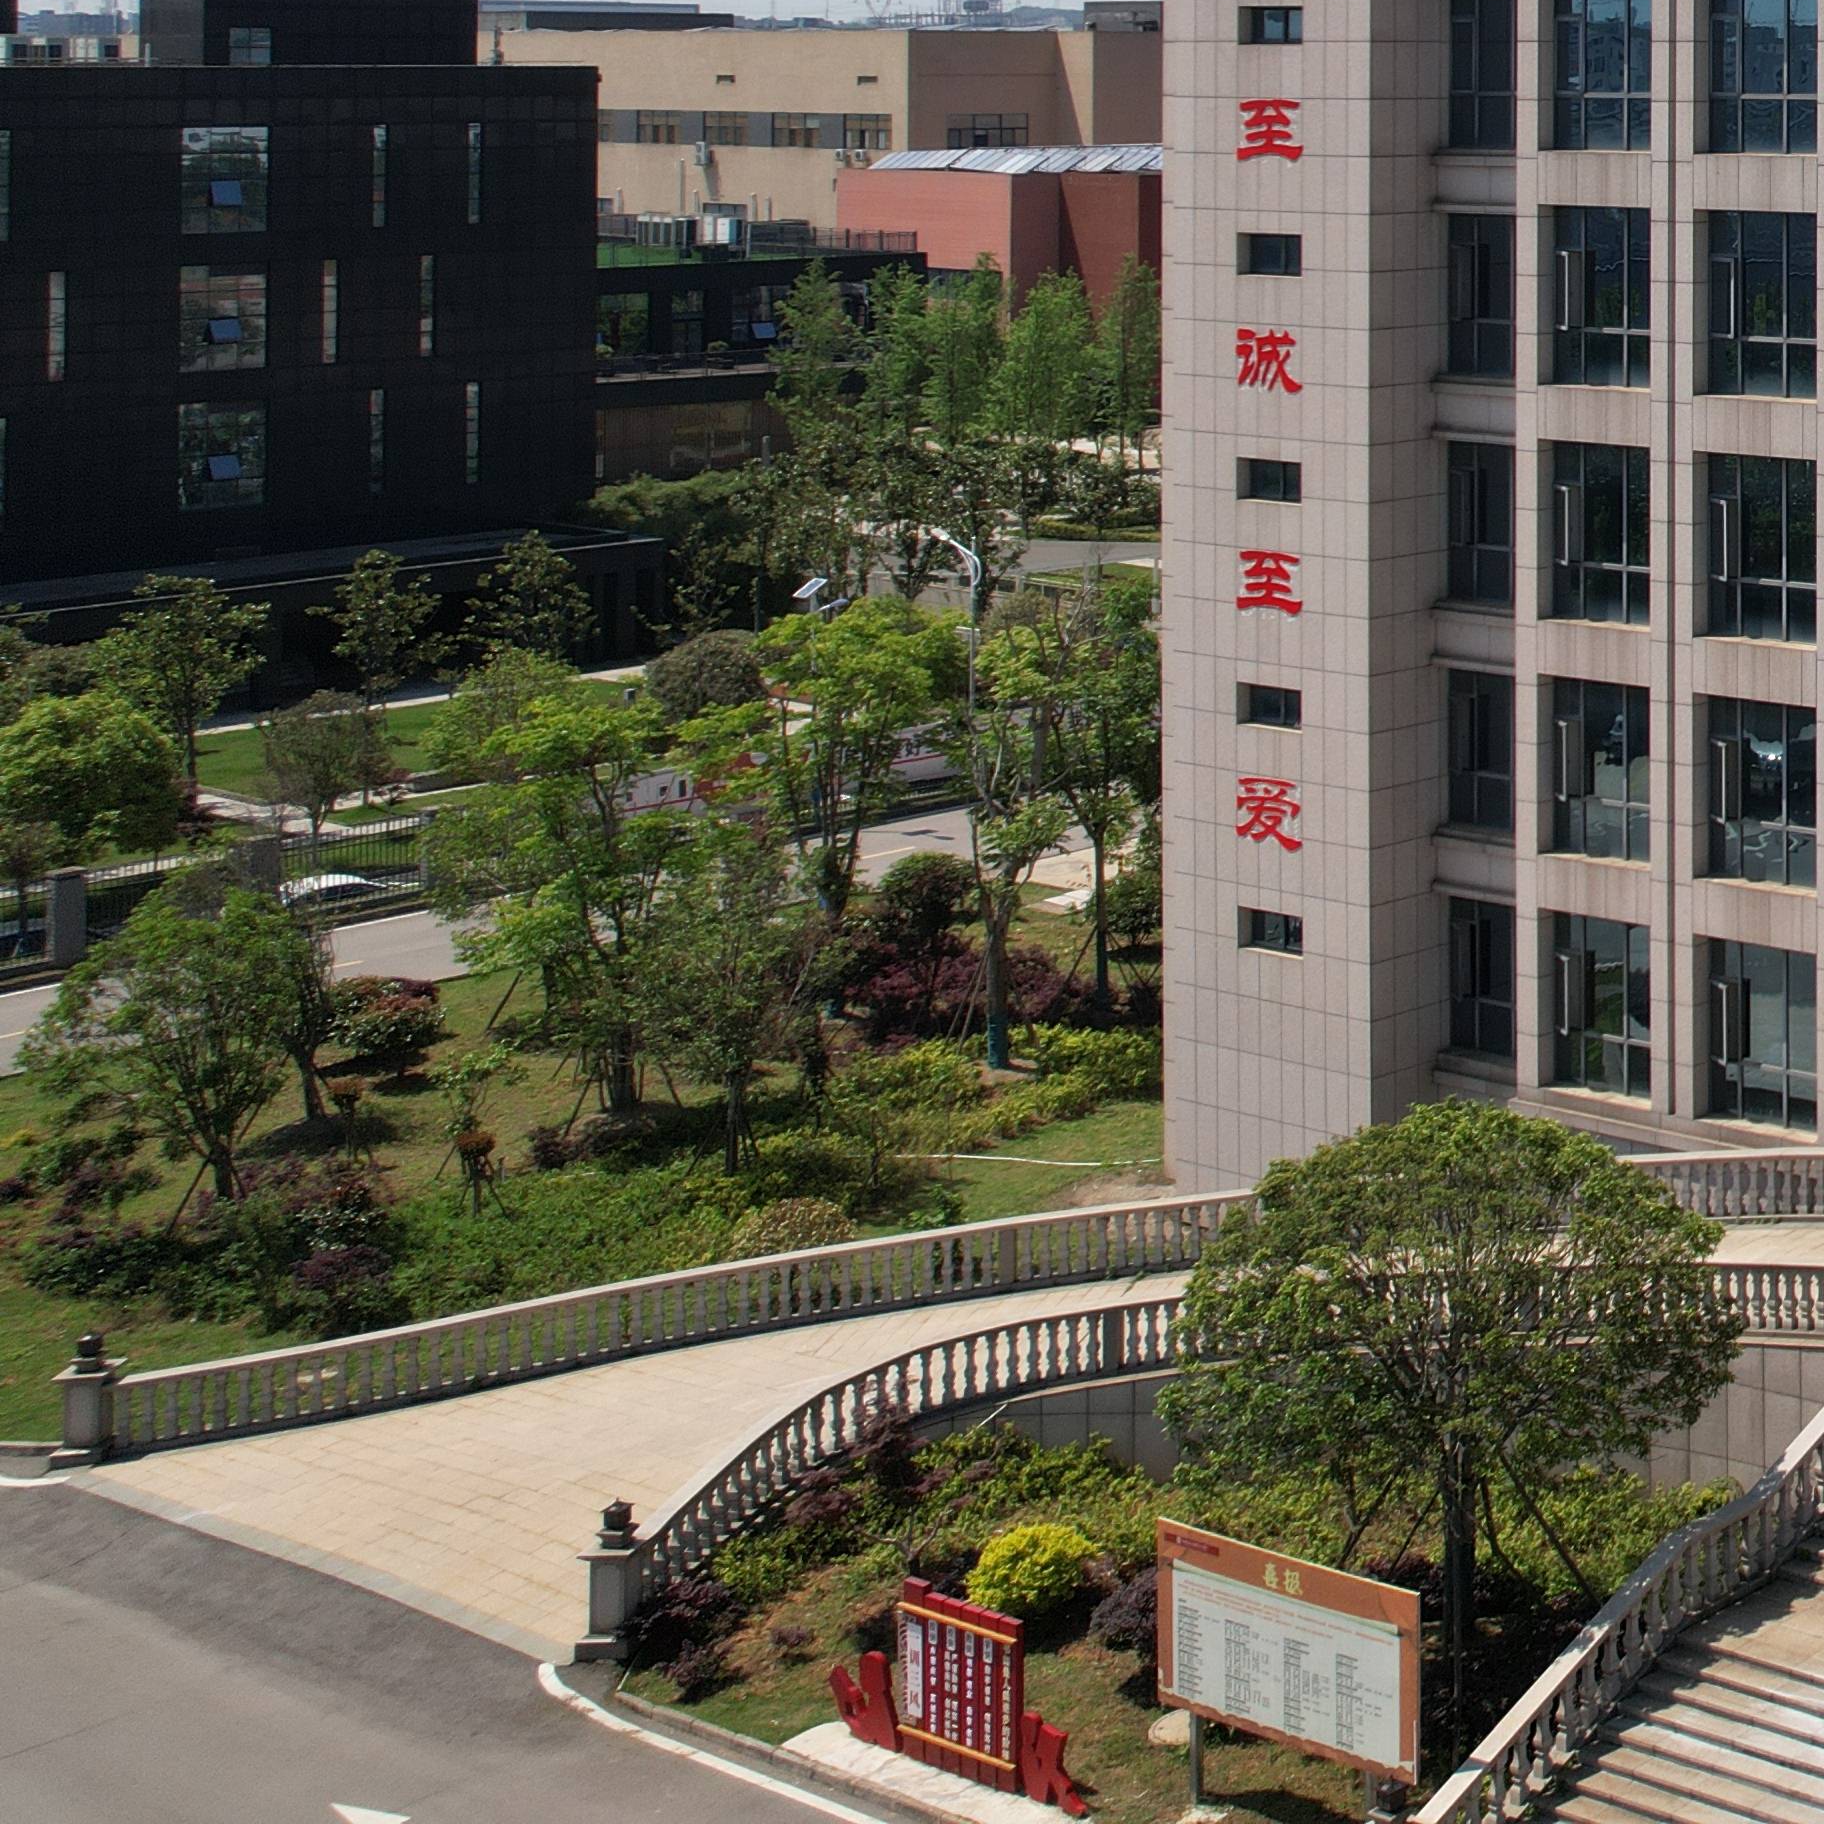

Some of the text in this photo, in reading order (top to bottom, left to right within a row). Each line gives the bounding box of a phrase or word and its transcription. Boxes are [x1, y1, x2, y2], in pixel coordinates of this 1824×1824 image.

[1236, 99, 1304, 853] 至诚至爱
[1262, 1561, 1303, 1597] 喜报
